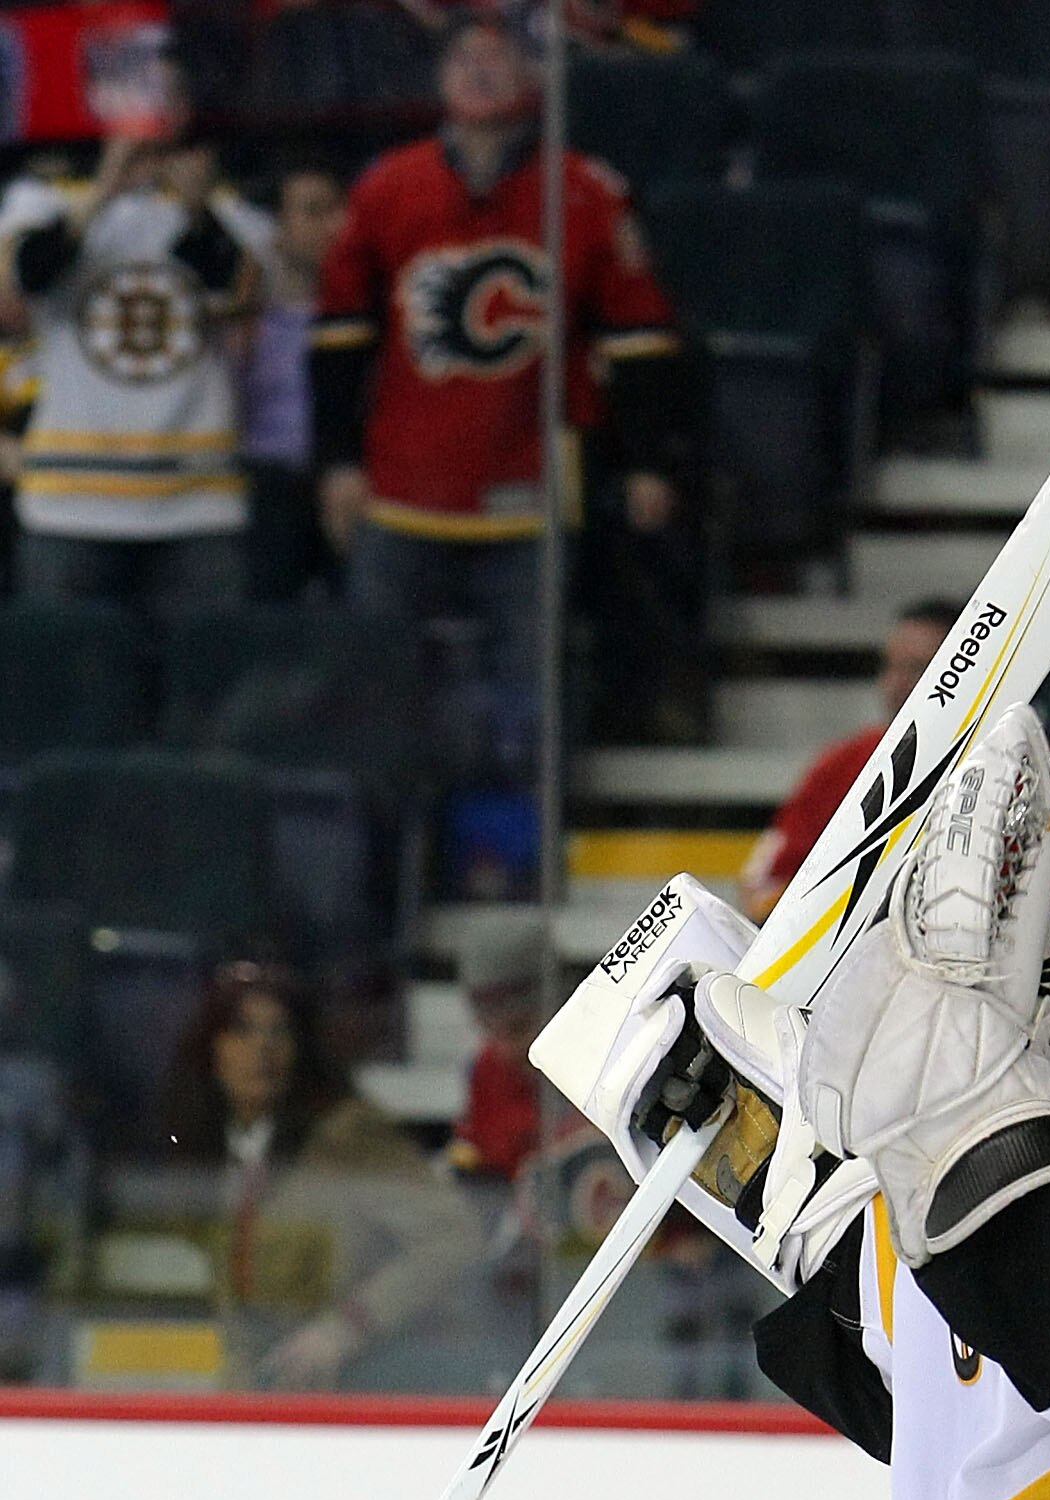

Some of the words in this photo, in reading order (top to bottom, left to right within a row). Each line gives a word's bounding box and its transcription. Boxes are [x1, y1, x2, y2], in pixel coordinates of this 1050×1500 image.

[926, 602, 1008, 709] Reebok
[599, 885, 678, 975] Reebok
[610, 895, 683, 984] LARCENY
